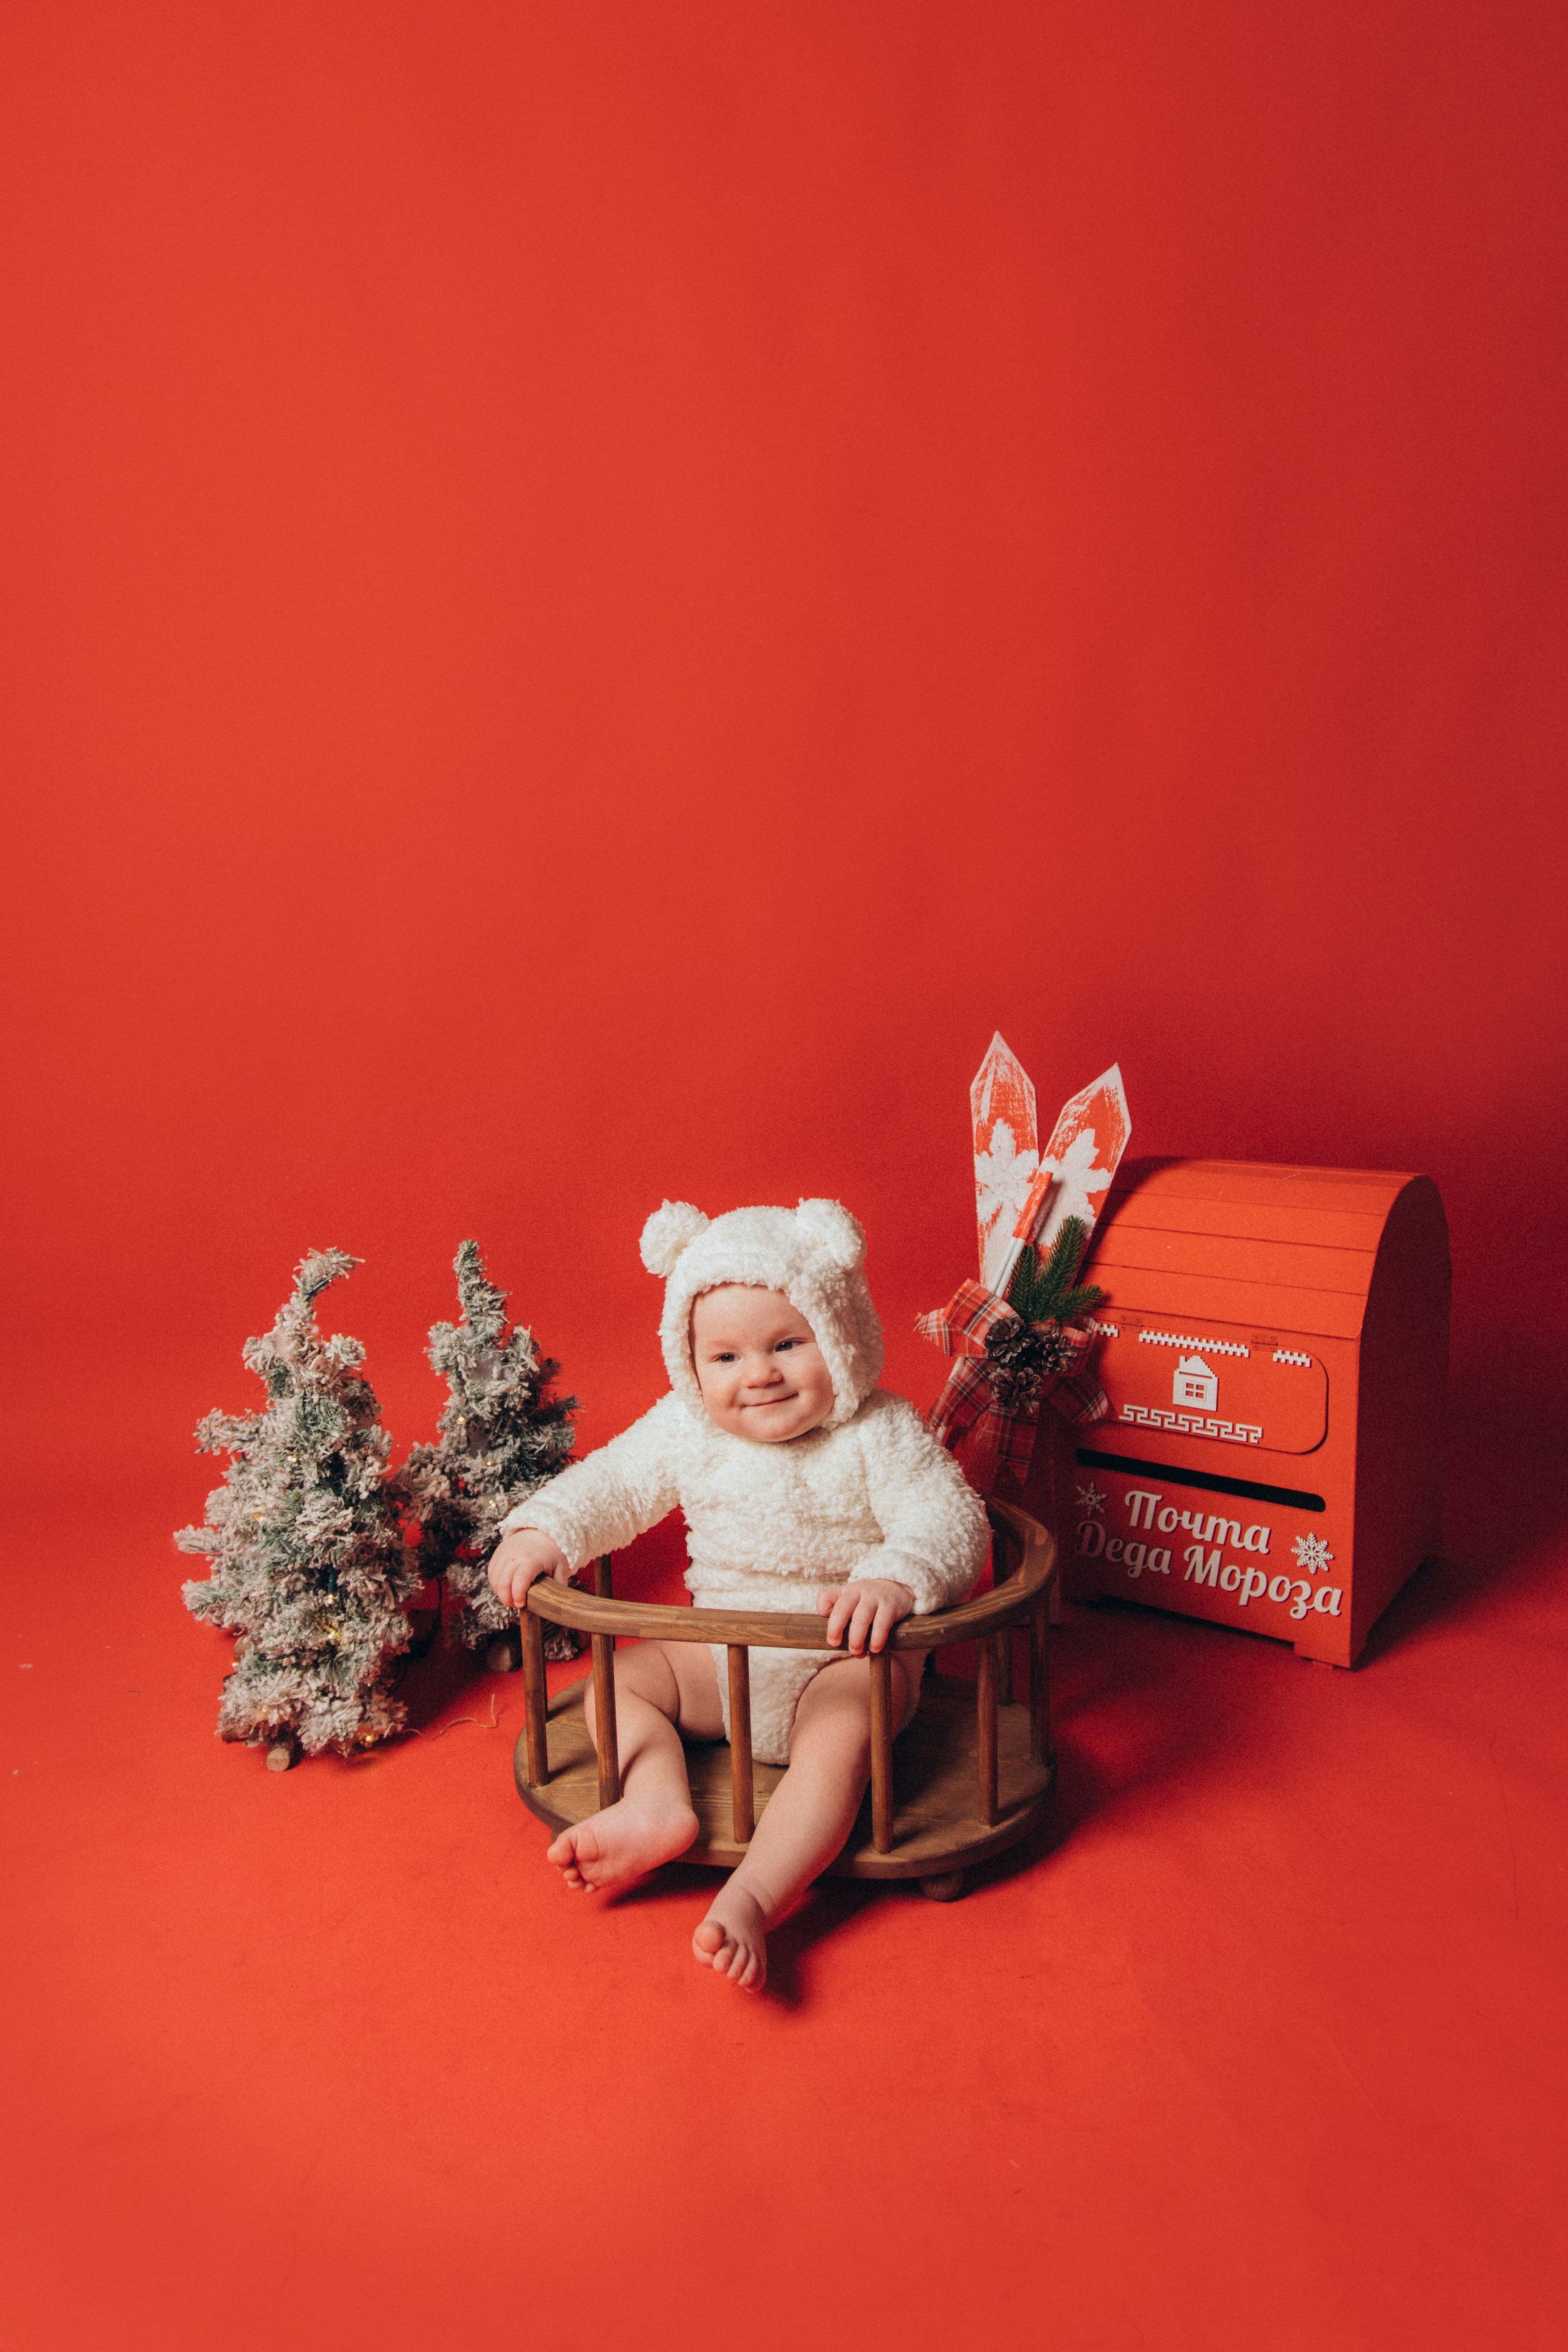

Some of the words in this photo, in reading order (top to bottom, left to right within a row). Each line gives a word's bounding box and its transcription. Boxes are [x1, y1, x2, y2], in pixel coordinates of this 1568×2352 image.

[1125, 1490, 1271, 1555] Почта
[1075, 1520, 1172, 1578] Деда
[1183, 1545, 1343, 1620] Мороза
